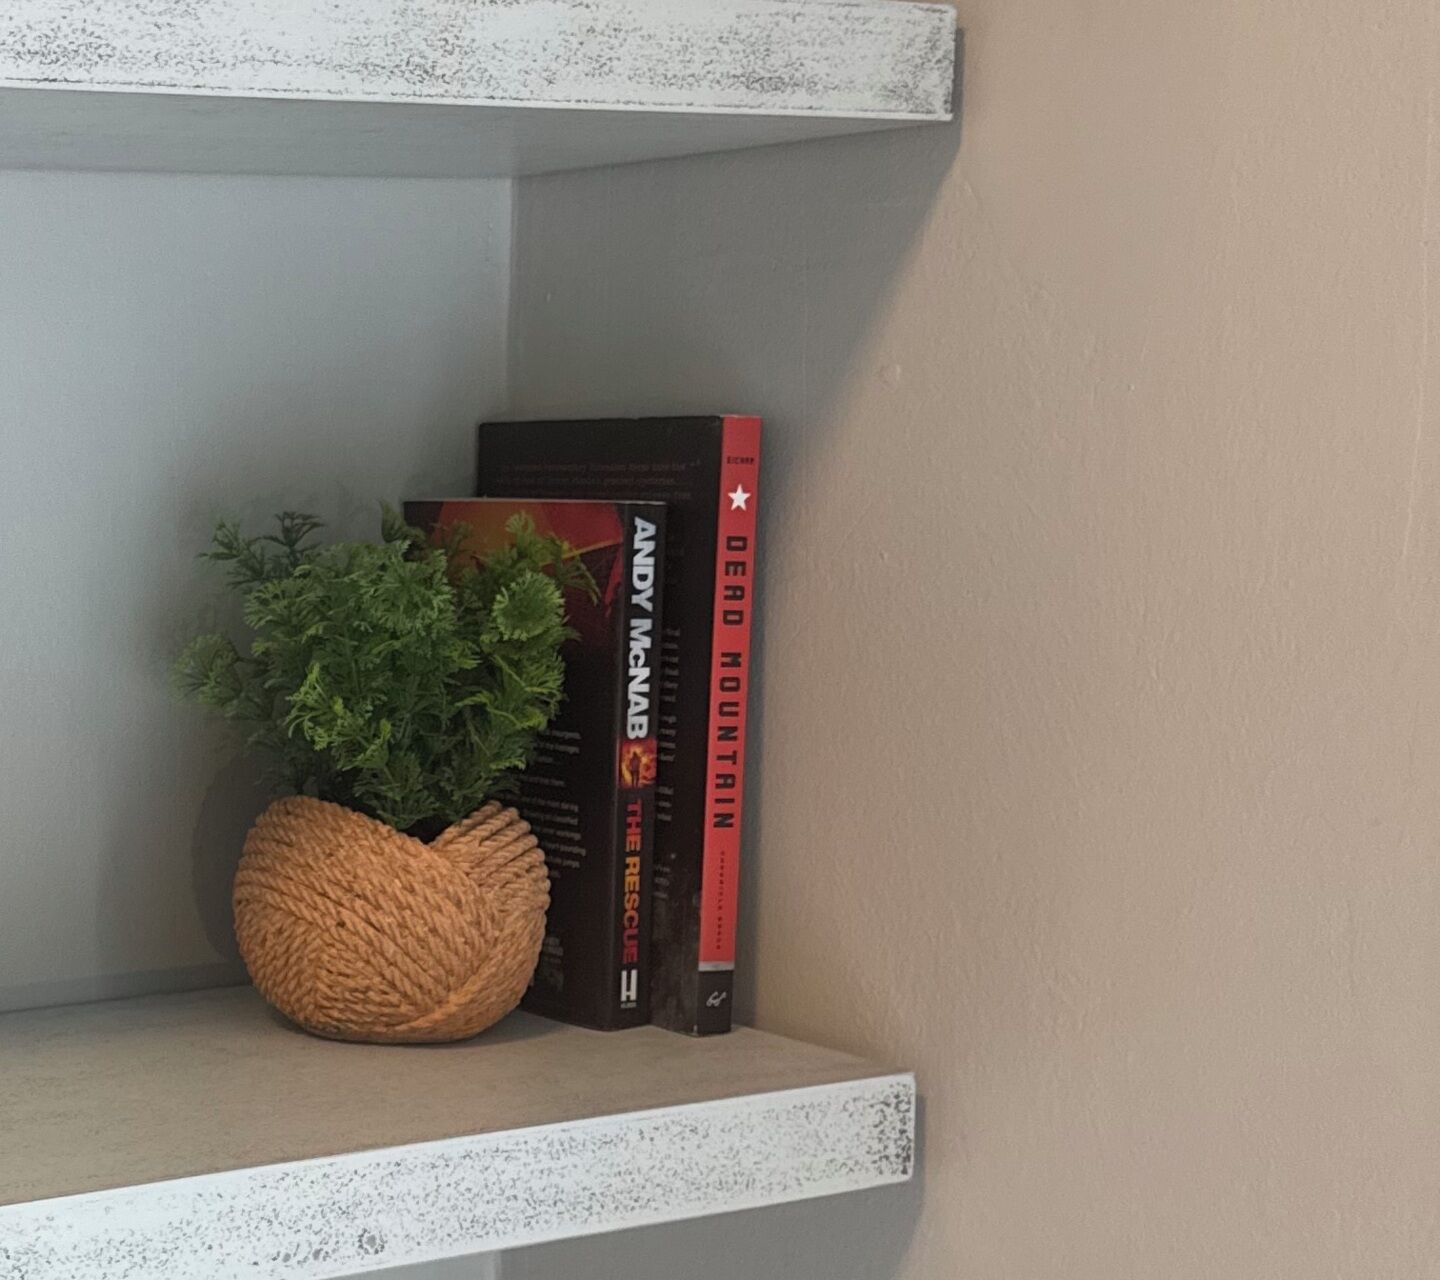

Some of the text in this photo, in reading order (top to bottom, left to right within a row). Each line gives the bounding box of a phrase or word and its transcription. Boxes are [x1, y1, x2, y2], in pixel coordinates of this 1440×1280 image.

[631, 516, 657, 612] ANDY
[714, 535, 748, 828] DEAD MOUNTAIN
[623, 799, 642, 964] THE RESCUE
